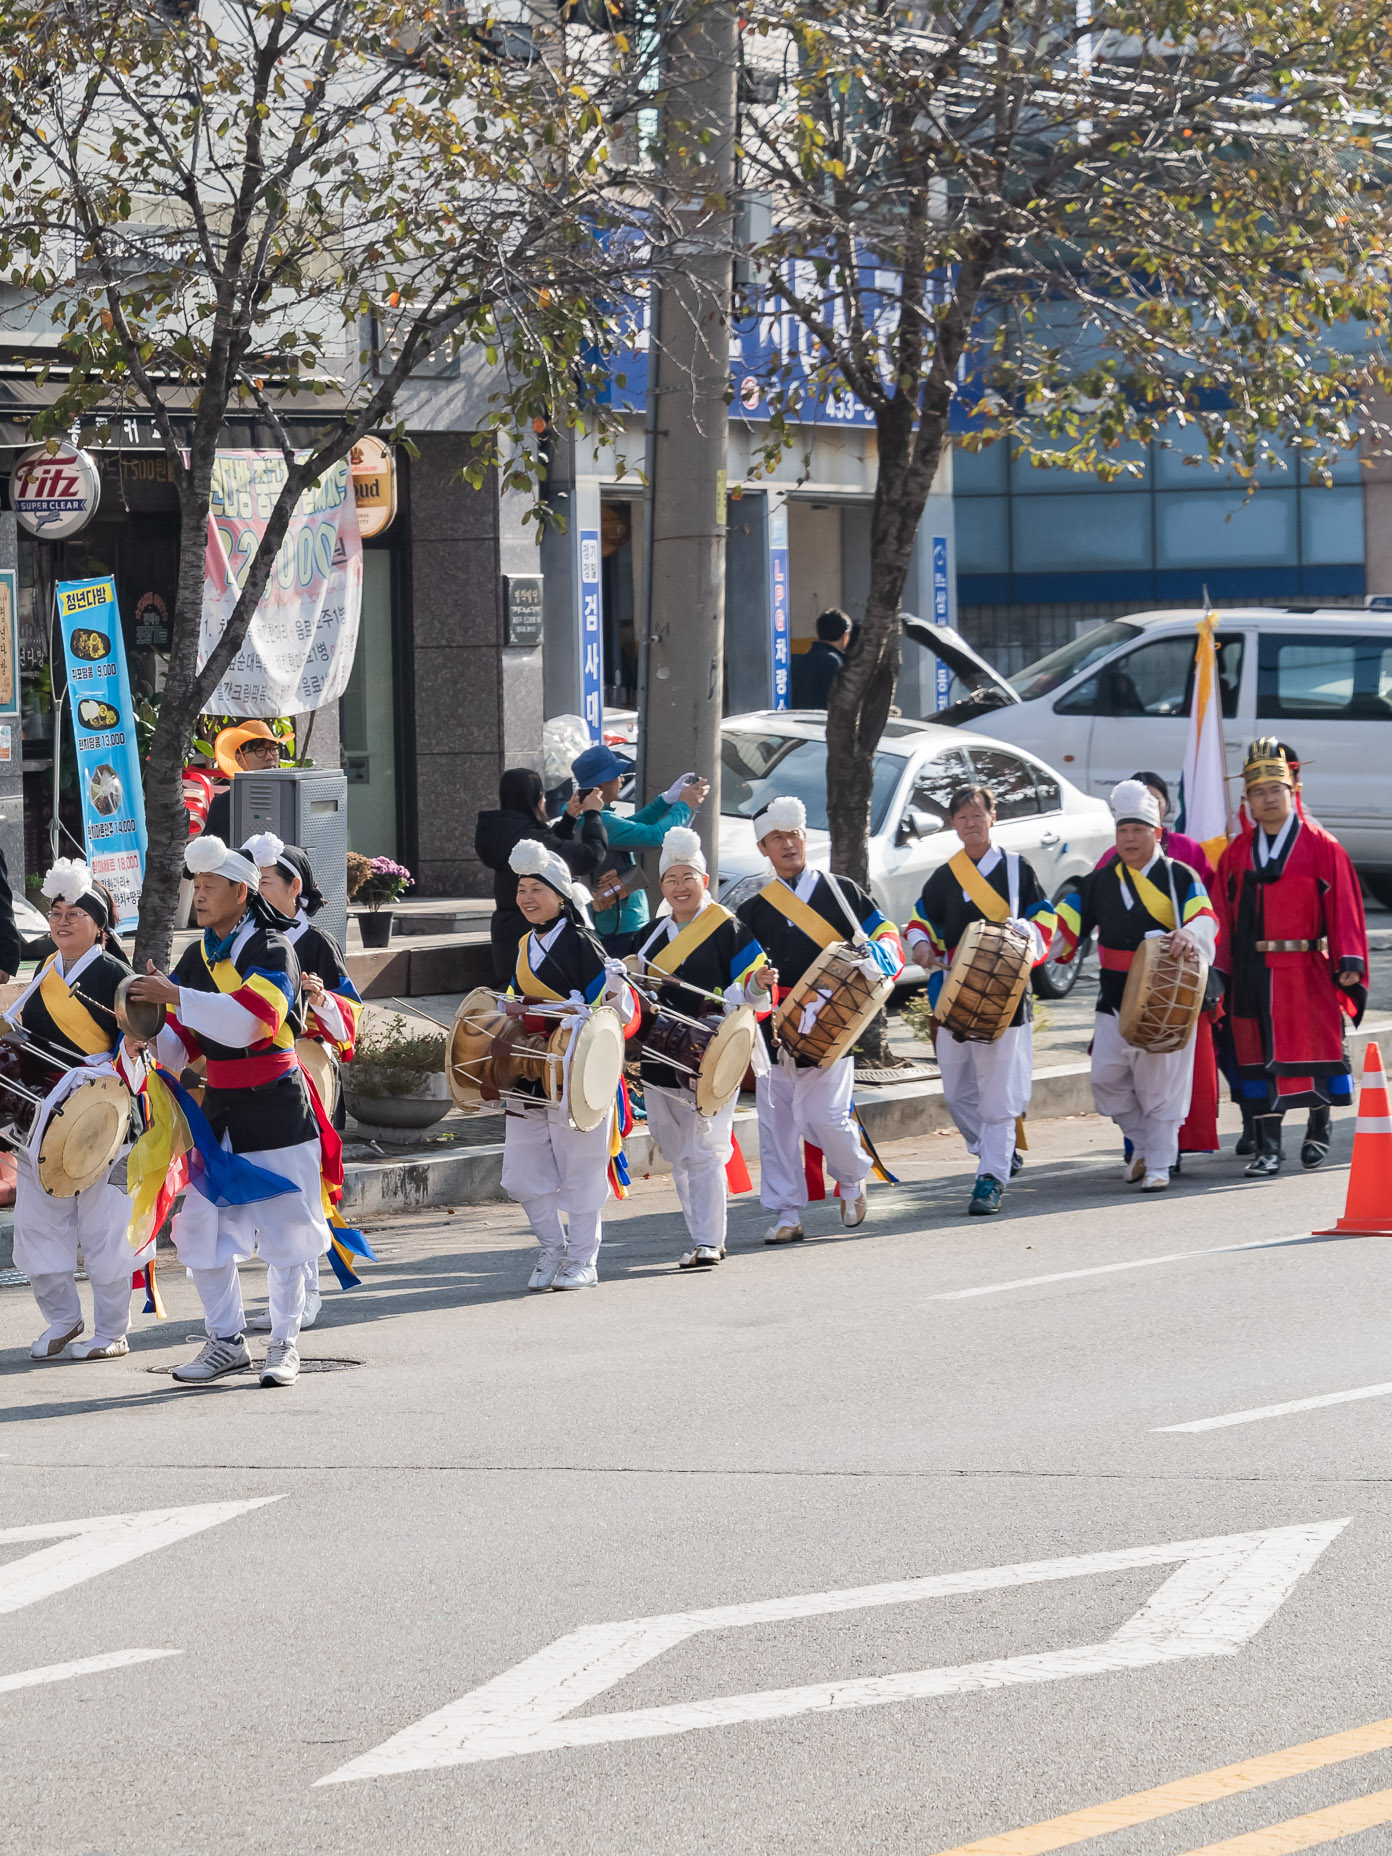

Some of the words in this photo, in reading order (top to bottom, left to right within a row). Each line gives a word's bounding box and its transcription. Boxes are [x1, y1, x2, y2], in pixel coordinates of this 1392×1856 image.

[20, 502, 48, 511] SUPER
[49, 501, 79, 510] CLEAR
[65, 586, 107, 612] 청년다방
[97, 663, 117, 678] 9,000
[101, 732, 126, 748] 13,000
[114, 819, 136, 834] 14,000
[117, 854, 139, 871] 18,000
